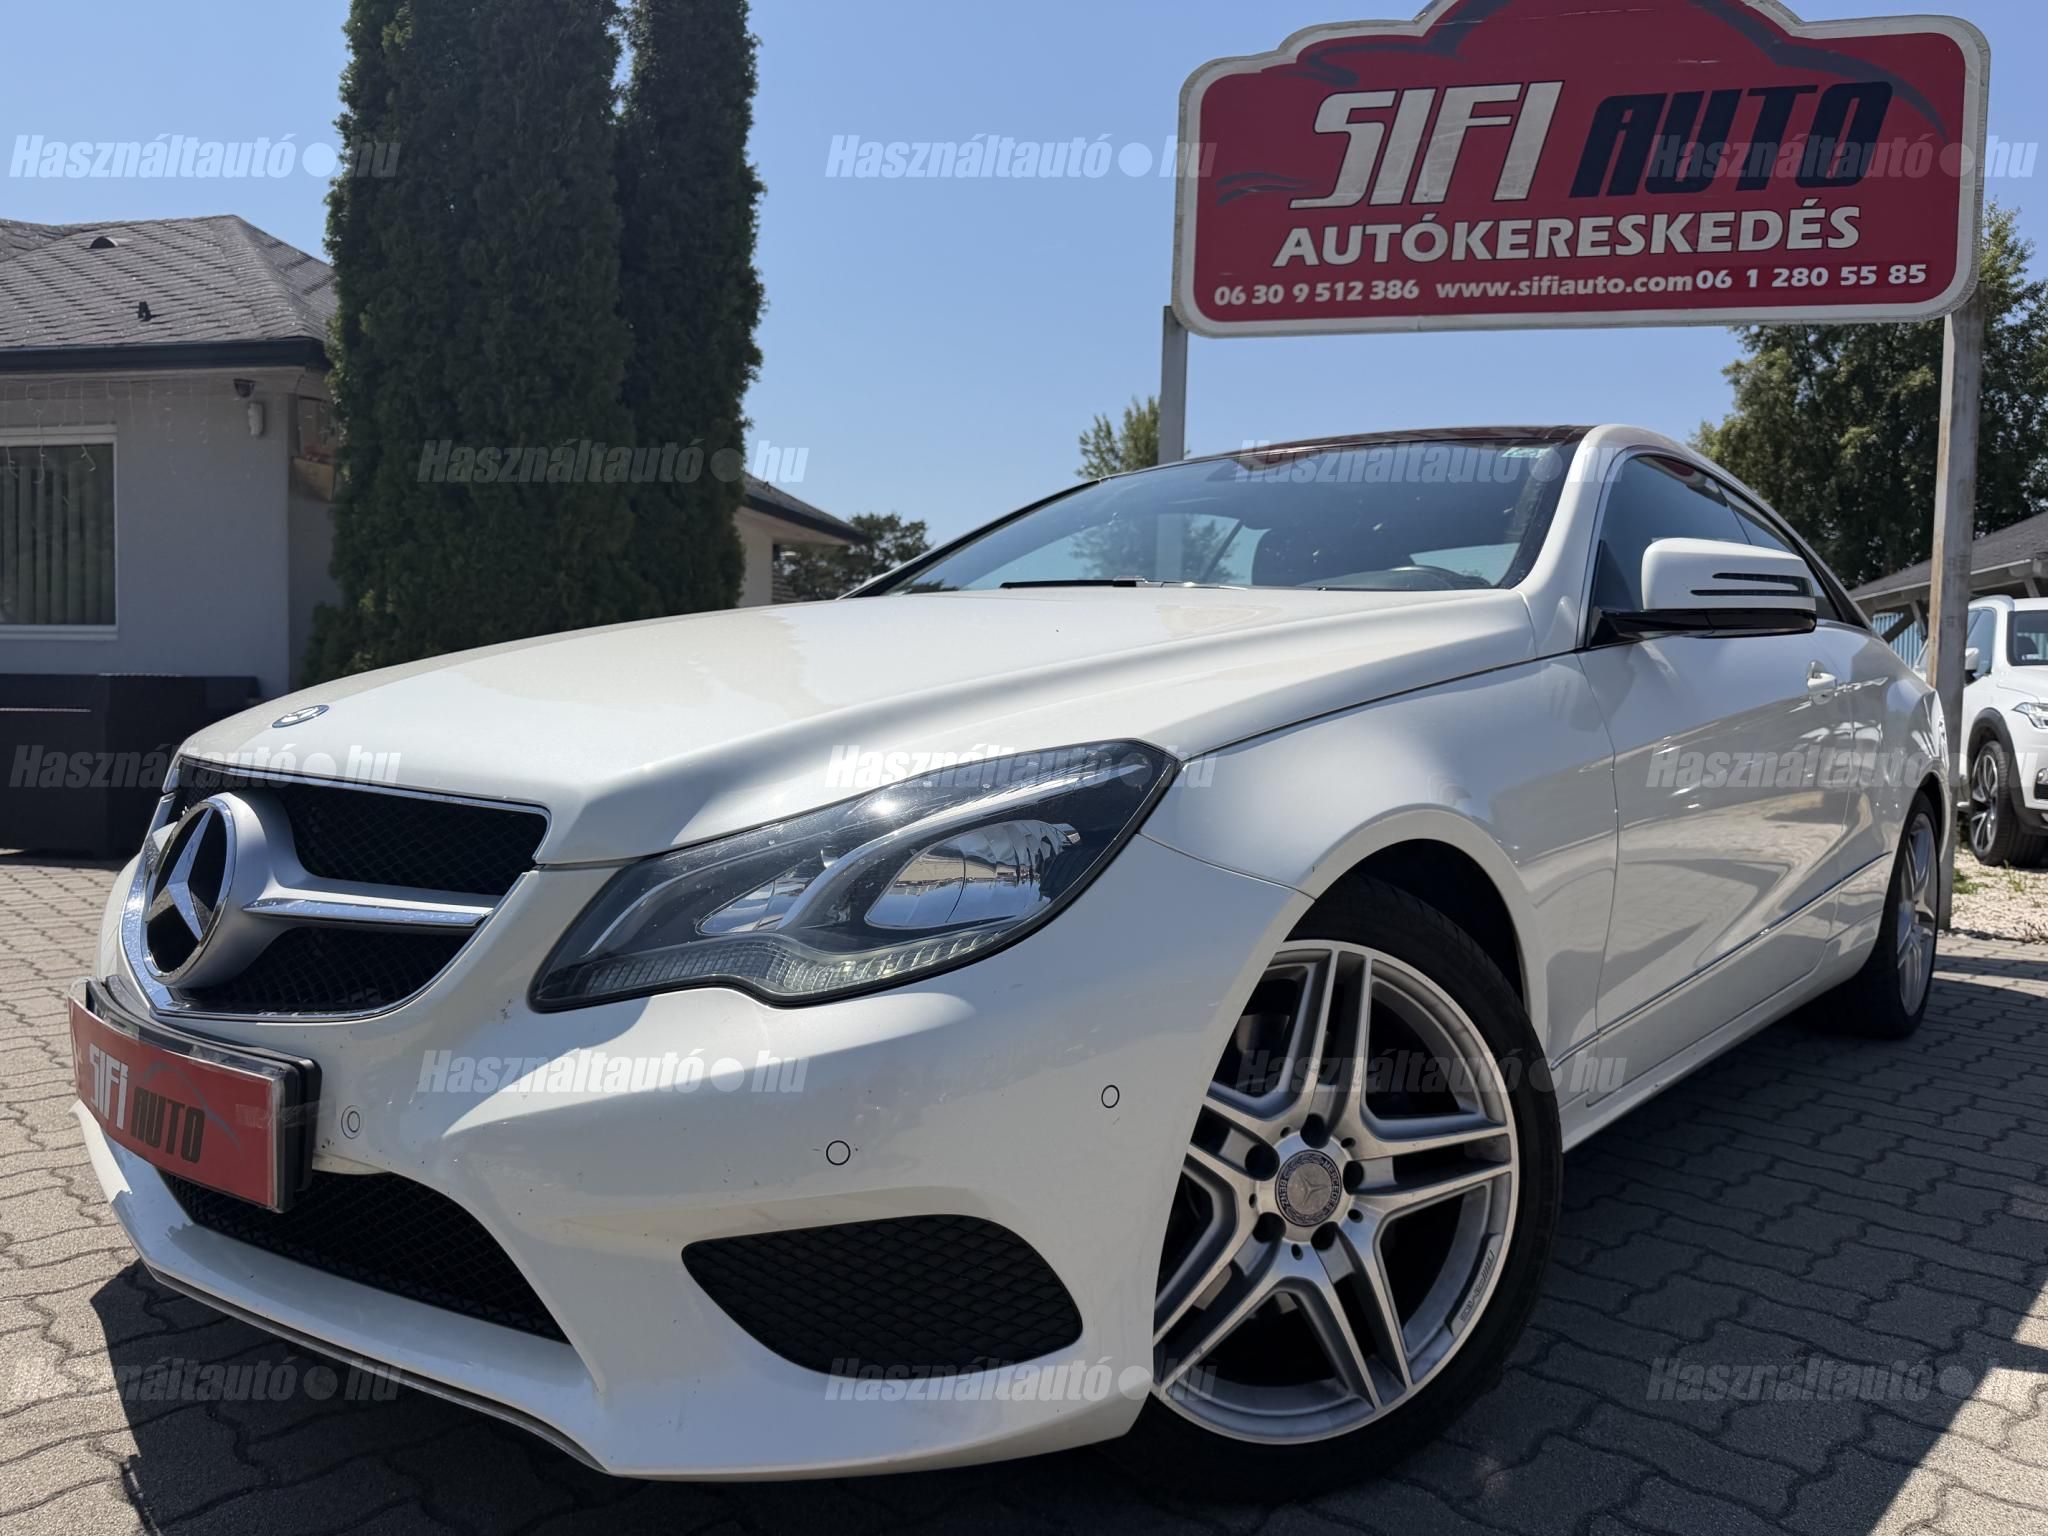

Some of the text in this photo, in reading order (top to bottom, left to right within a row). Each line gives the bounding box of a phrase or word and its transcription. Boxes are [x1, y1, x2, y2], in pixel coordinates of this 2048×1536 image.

[1289, 80, 1894, 209] SIFI AUTO
[1272, 198, 1862, 268] AUTÓKERESKEDÉS
[1214, 286, 1246, 306] 06
[1251, 284, 1285, 305] 30
[1369, 280, 1420, 300] 386
[1435, 275, 1693, 298] www.sifiauto.com
[1696, 264, 1927, 289] 06 1 280 55 85
[130, 1086, 206, 1164] AUTO
